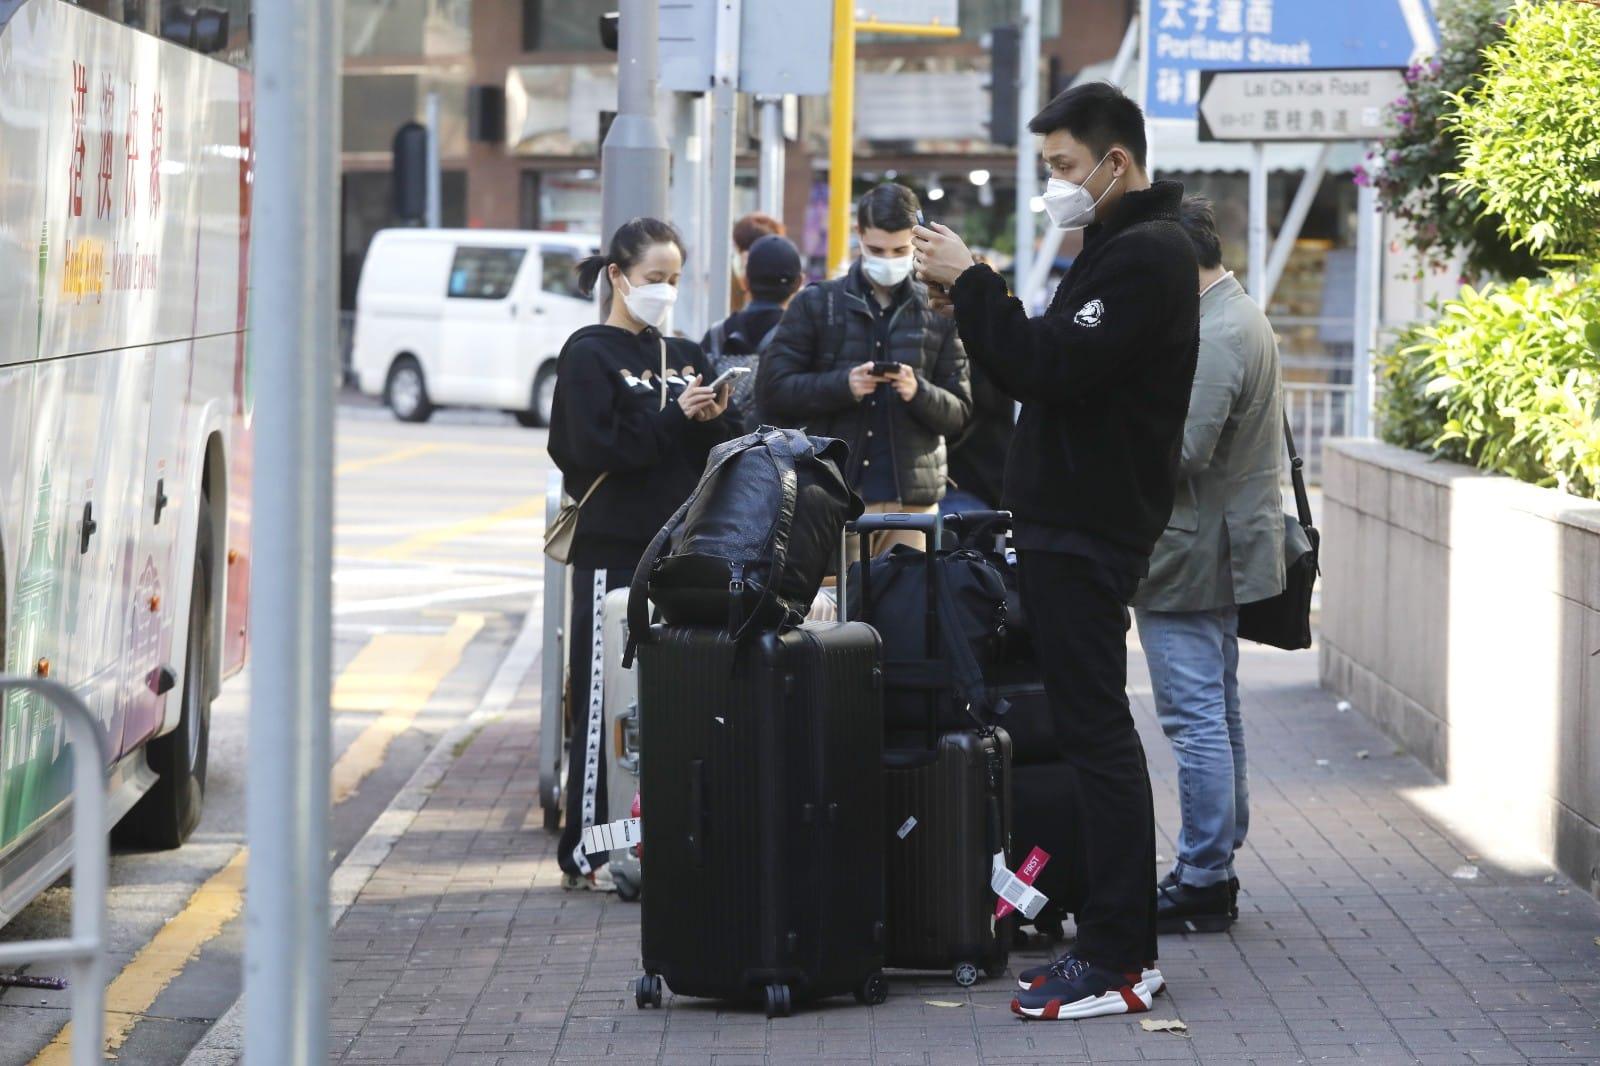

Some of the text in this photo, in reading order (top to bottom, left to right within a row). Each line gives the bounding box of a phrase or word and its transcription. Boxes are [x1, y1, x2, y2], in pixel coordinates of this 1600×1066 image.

[1157, 33, 1311, 65] Portland Street
[1244, 77, 1370, 96] Lai Chi Kok Road
[1024, 855, 1040, 876] FIRST
